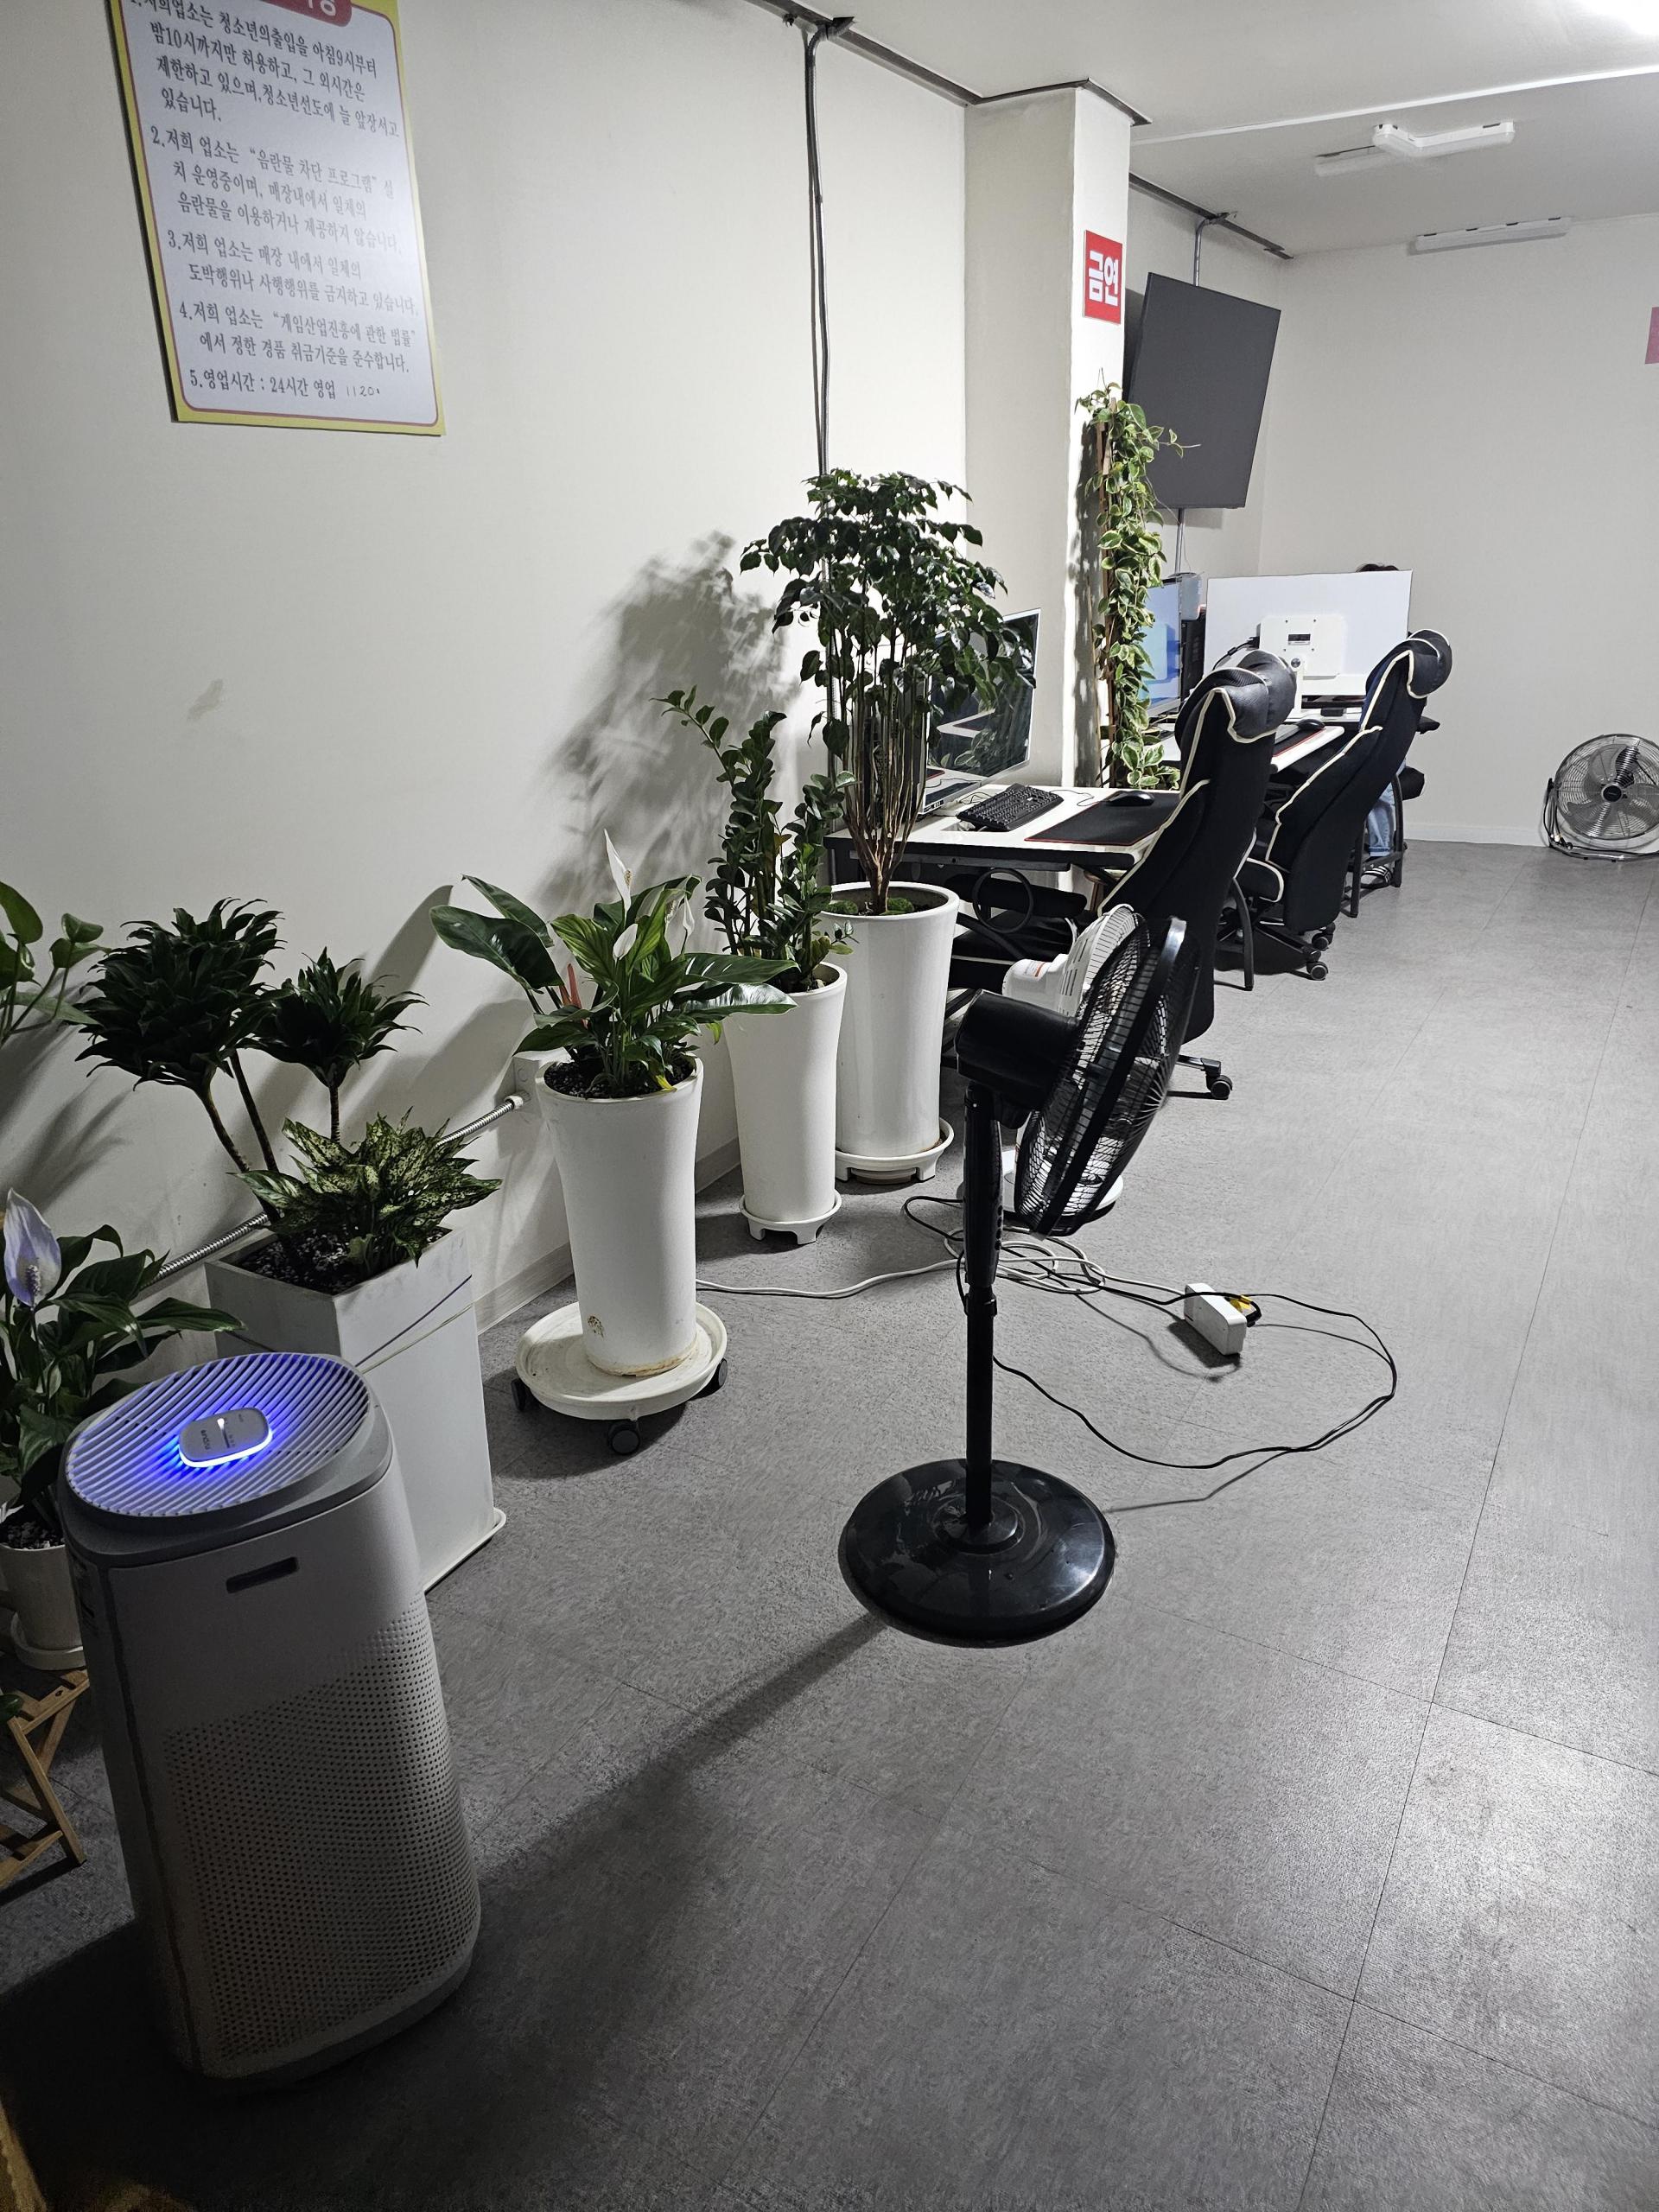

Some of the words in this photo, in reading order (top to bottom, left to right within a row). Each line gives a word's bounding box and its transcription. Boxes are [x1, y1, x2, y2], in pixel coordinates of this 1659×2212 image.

[150, 22, 237, 66] 밤10시까지만
[302, 68, 315, 86] 그
[319, 68, 365, 103] 외시간은
[219, 11, 308, 58] 청소년의출입을
[313, 42, 377, 79] 아침9시부터
[156, 55, 211, 88] 제한하고
[340, 105, 352, 126] 늘
[355, 111, 399, 137] 앞장서고
[162, 87, 222, 122] 있습니다.
[200, 136, 240, 163] 업소는
[299, 159, 322, 182] 차단
[173, 161, 187, 182] 치
[269, 181, 328, 212] 매장내에서
[333, 196, 366, 221] 일체의
[177, 191, 232, 221] 음란물을
[238, 205, 299, 236] 이용하거나
[304, 217, 350, 243] 제공하지
[168, 231, 208, 254] 3.저희
[214, 238, 253, 263] 업소는
[258, 245, 283, 266] 매장
[289, 250, 324, 275] 내에서
[327, 257, 361, 281] 일체의
[1089, 250, 1119, 307] 금연
[188, 264, 254, 292] 도박행위나
[259, 274, 320, 302] 사행행위를
[325, 284, 369, 308] 금지하고
[373, 292, 418, 315] 있습니다.
[179, 302, 219, 325] 4.저희
[226, 305, 264, 330] 업소는
[365, 326, 387, 346] 관한
[200, 333, 226, 354] 에서
[232, 338, 257, 358] 정한
[262, 340, 285, 359] 경품
[291, 341, 348, 367] 취금기준을
[353, 346, 410, 373] 준수합니다.
[270, 377, 308, 397] 24시간
[314, 379, 335, 399] 영업
